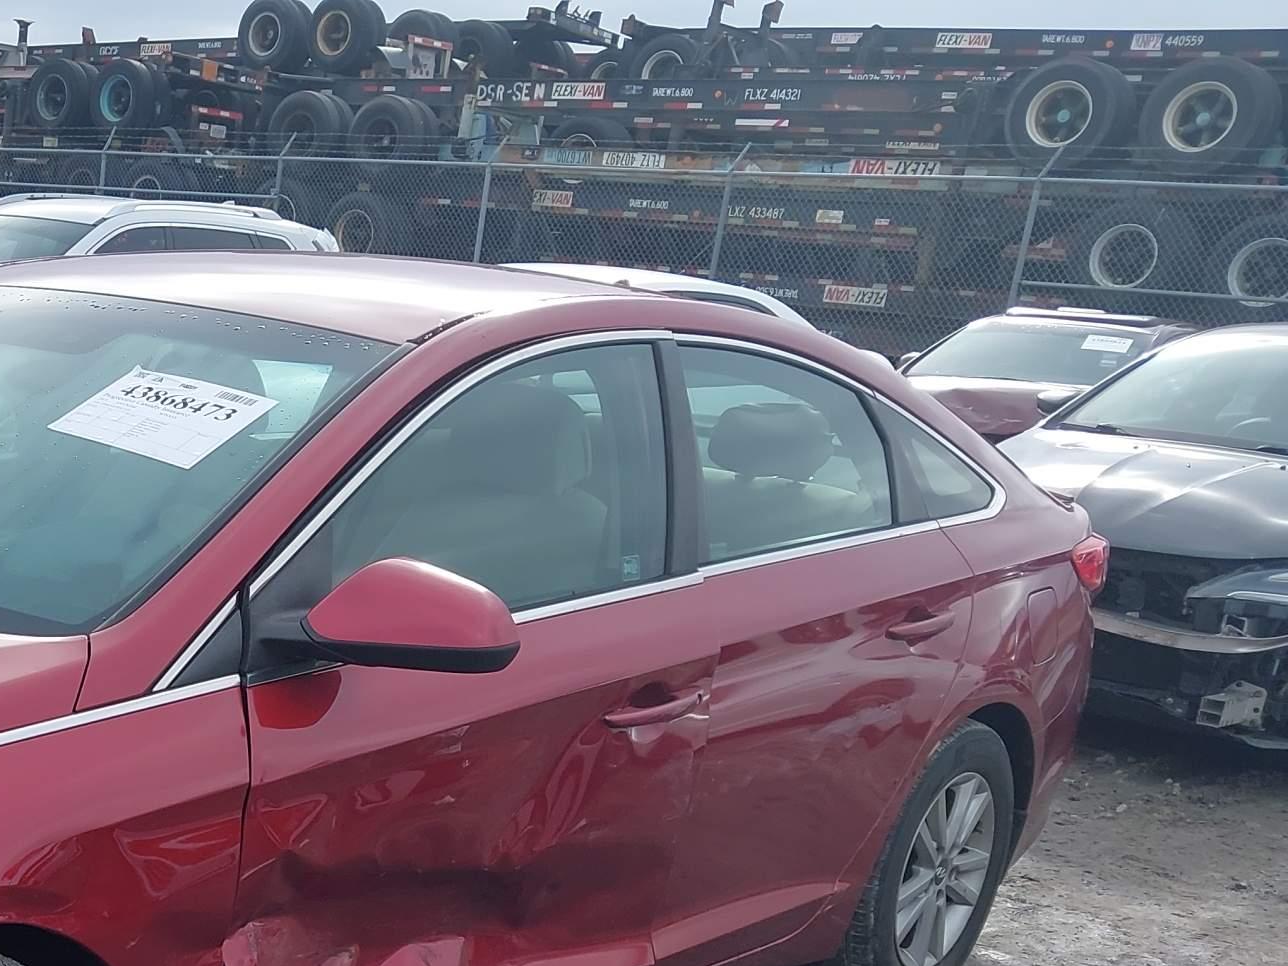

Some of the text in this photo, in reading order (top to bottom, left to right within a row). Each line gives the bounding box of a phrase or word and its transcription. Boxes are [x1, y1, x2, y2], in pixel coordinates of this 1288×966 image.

[937, 33, 992, 48] FLEXI-VAN
[1165, 35, 1204, 47] 440559
[552, 82, 605, 99] FLEXI-VAN
[744, 88, 801, 101] FLXZ 414321
[851, 158, 940, 175] FLEXI-VAN
[749, 207, 785, 219] 433487
[825, 286, 887, 305] FLEXI-VAN
[120, 384, 238, 421] 43868473
